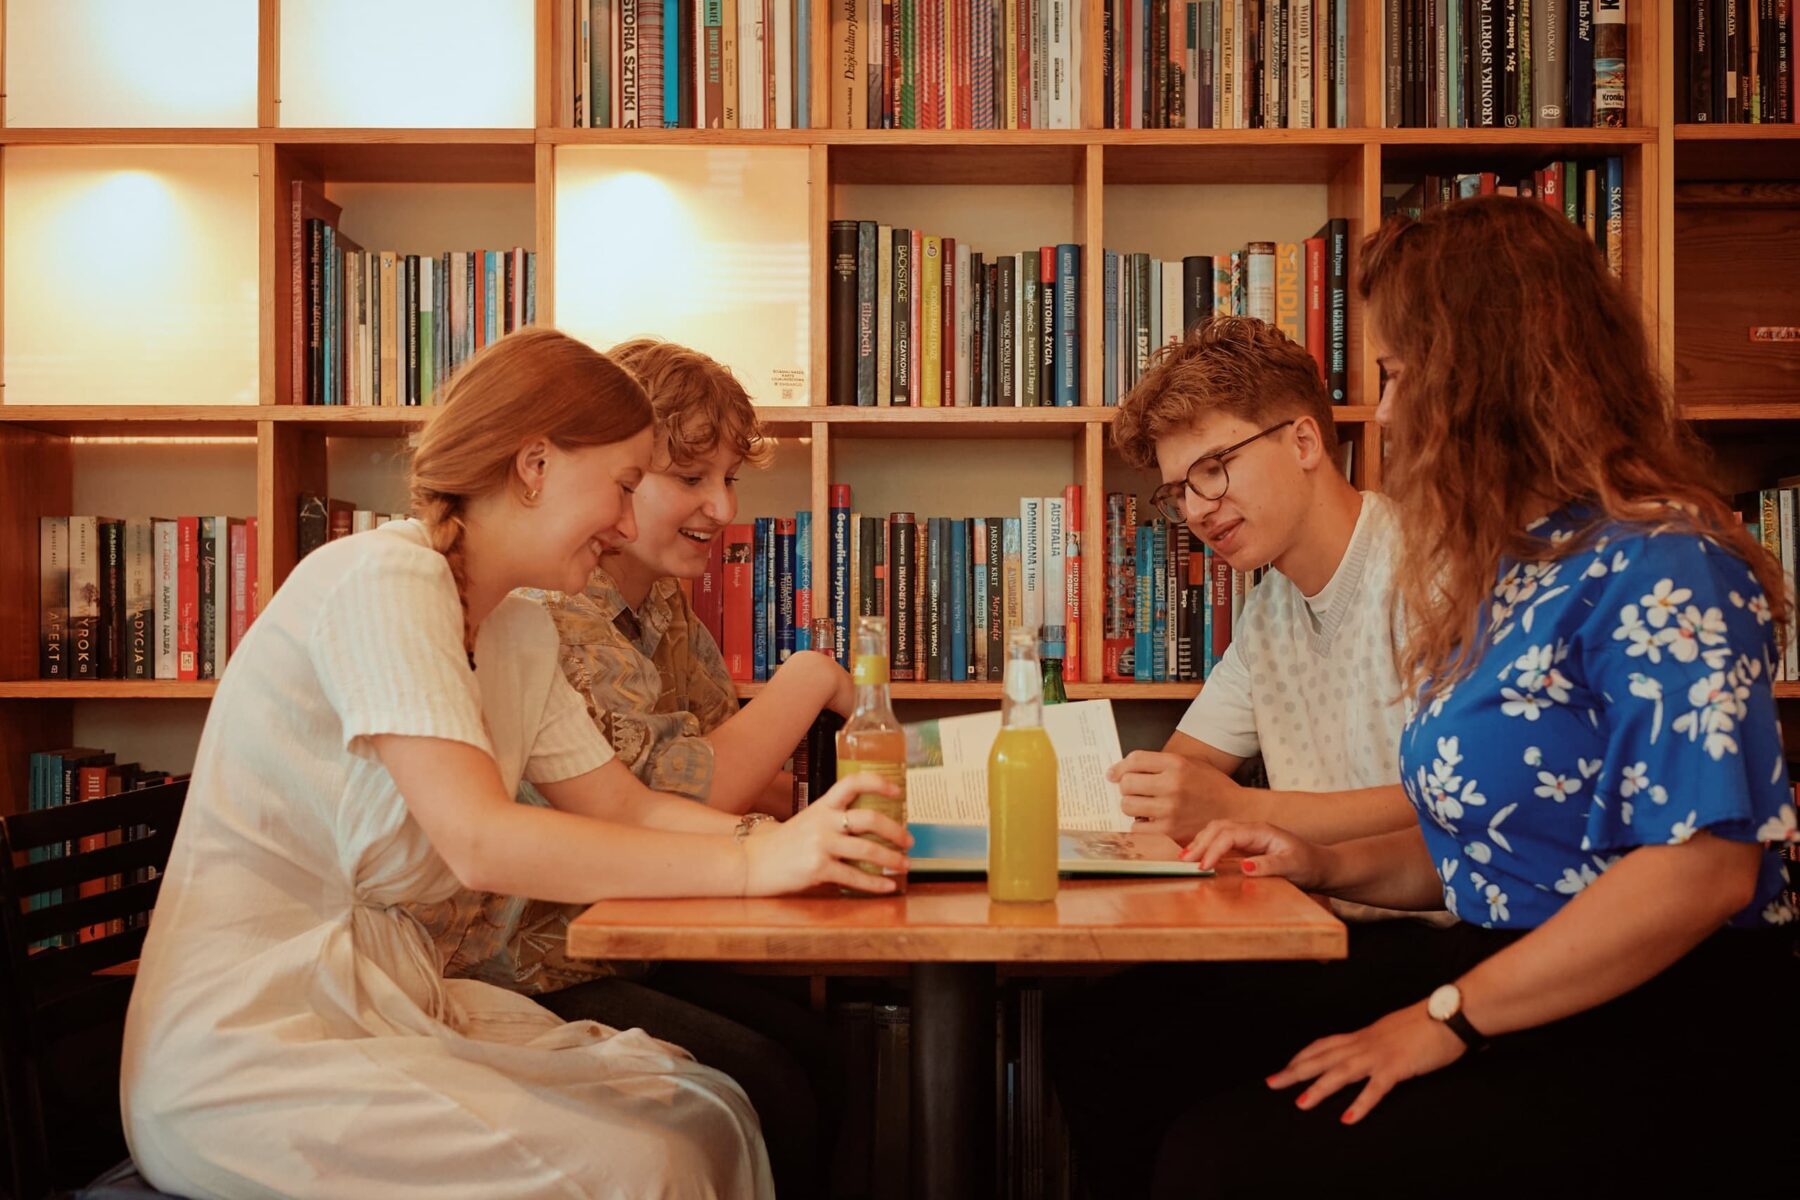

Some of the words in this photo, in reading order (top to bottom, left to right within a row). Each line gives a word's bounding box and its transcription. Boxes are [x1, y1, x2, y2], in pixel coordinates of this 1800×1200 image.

[1300, 4, 1309, 39] WOODY
[1579, 1, 1590, 18] lub
[1728, 0, 1736, 37] DEKADA
[1481, 14, 1493, 64] SPORTU
[1547, 14, 1557, 62] ŚWIADKAMI
[1579, 19, 1590, 41] Nie!
[1300, 45, 1309, 79] ALLEN
[624, 56, 635, 111] SZTUKI
[1481, 67, 1493, 125] KRONIKA
[1611, 186, 1622, 236] SKARBY
[897, 245, 907, 303] BACKSTAGE
[1045, 288, 1053, 334] HISTORIA
[1063, 275, 1075, 317] KOWALEWSKI
[1333, 288, 1343, 308] ANNA
[861, 302, 872, 357] Elizabeth
[899, 321, 907, 338] PIOTR
[1333, 309, 1343, 341] GERMAN
[899, 339, 907, 386] CZAYKOWSKI
[1045, 336, 1054, 366] ŻYCIA
[1333, 349, 1343, 374] SOBIE
[834, 512, 846, 564] Geografia
[990, 526, 998, 566] JAROSŁAW
[1028, 502, 1038, 565] DOMINIKANA
[1051, 503, 1061, 557] AUSTRALIA
[703, 573, 712, 593] INDIE
[834, 565, 846, 623] turystyczna
[898, 566, 906, 610] CEJROWSKI
[990, 567, 998, 586] KRET
[1216, 564, 1227, 606] Bulgaria
[931, 613, 937, 623] NA
[990, 595, 1000, 617] Moje
[48, 612, 59, 662] AFEKT
[836, 625, 846, 658] świata
[898, 611, 906, 651] WOJCIECH
[88, 775, 100, 793] Jill
